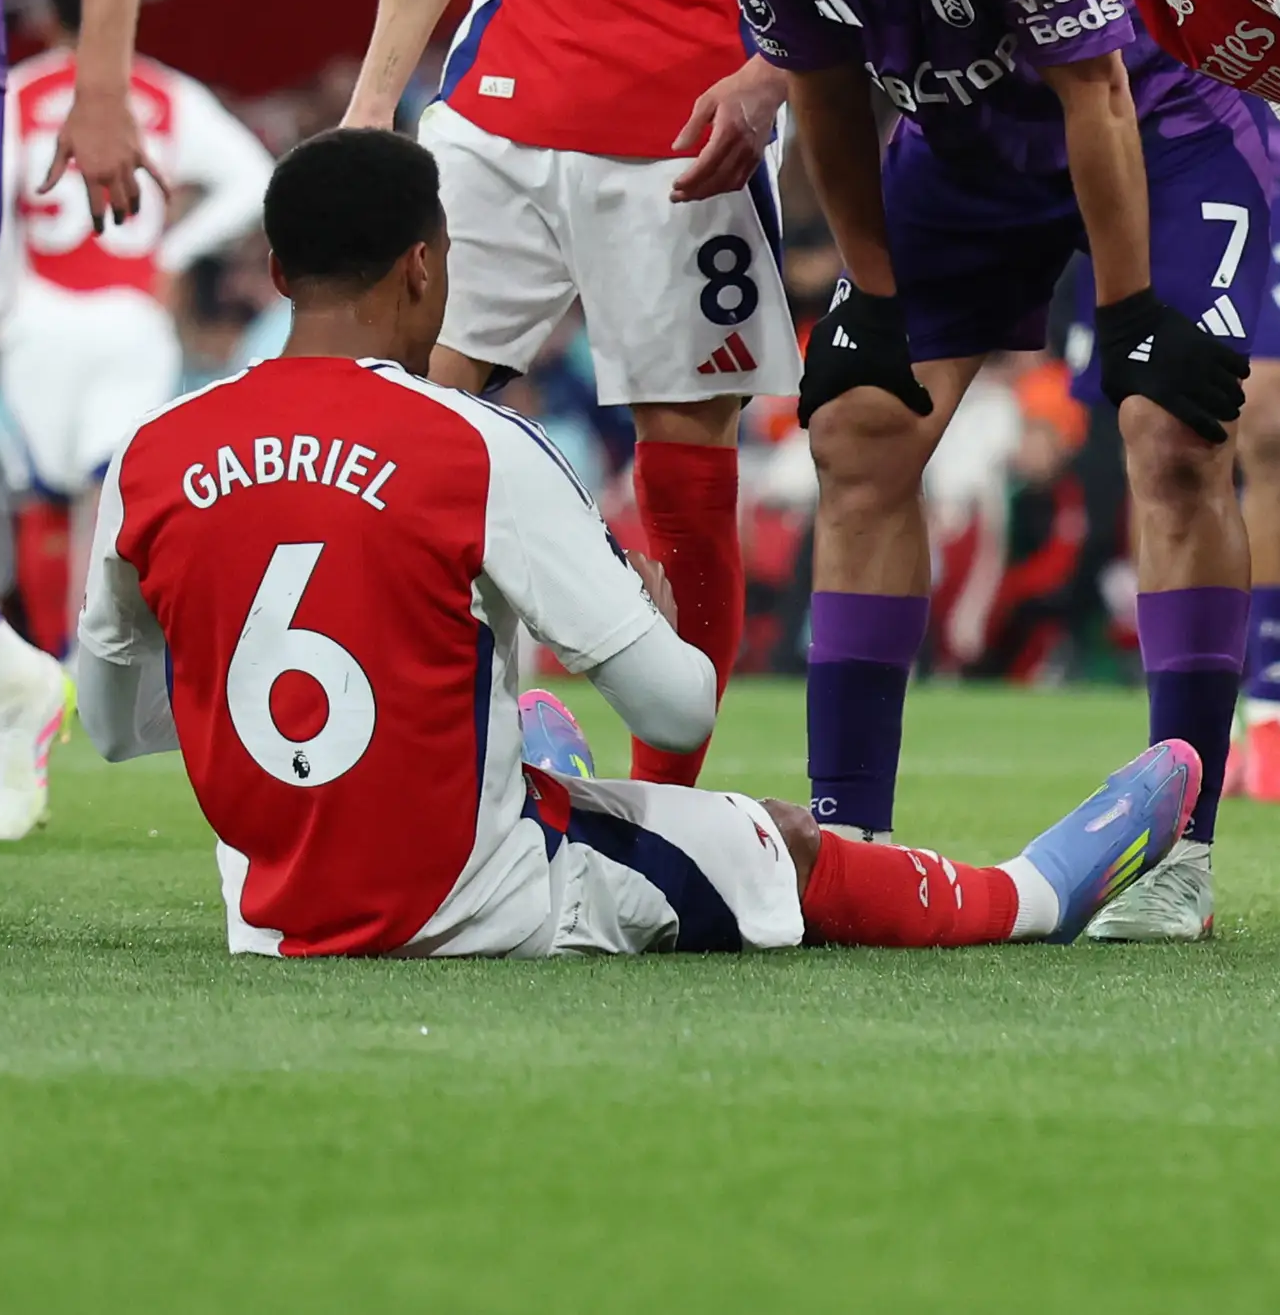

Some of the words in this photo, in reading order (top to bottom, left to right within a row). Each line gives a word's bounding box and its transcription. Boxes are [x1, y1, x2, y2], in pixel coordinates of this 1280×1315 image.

[696, 234, 759, 327] 8
[1201, 201, 1250, 289] 7
[181, 434, 398, 512] GABRIEL
[225, 541, 378, 789] 6
